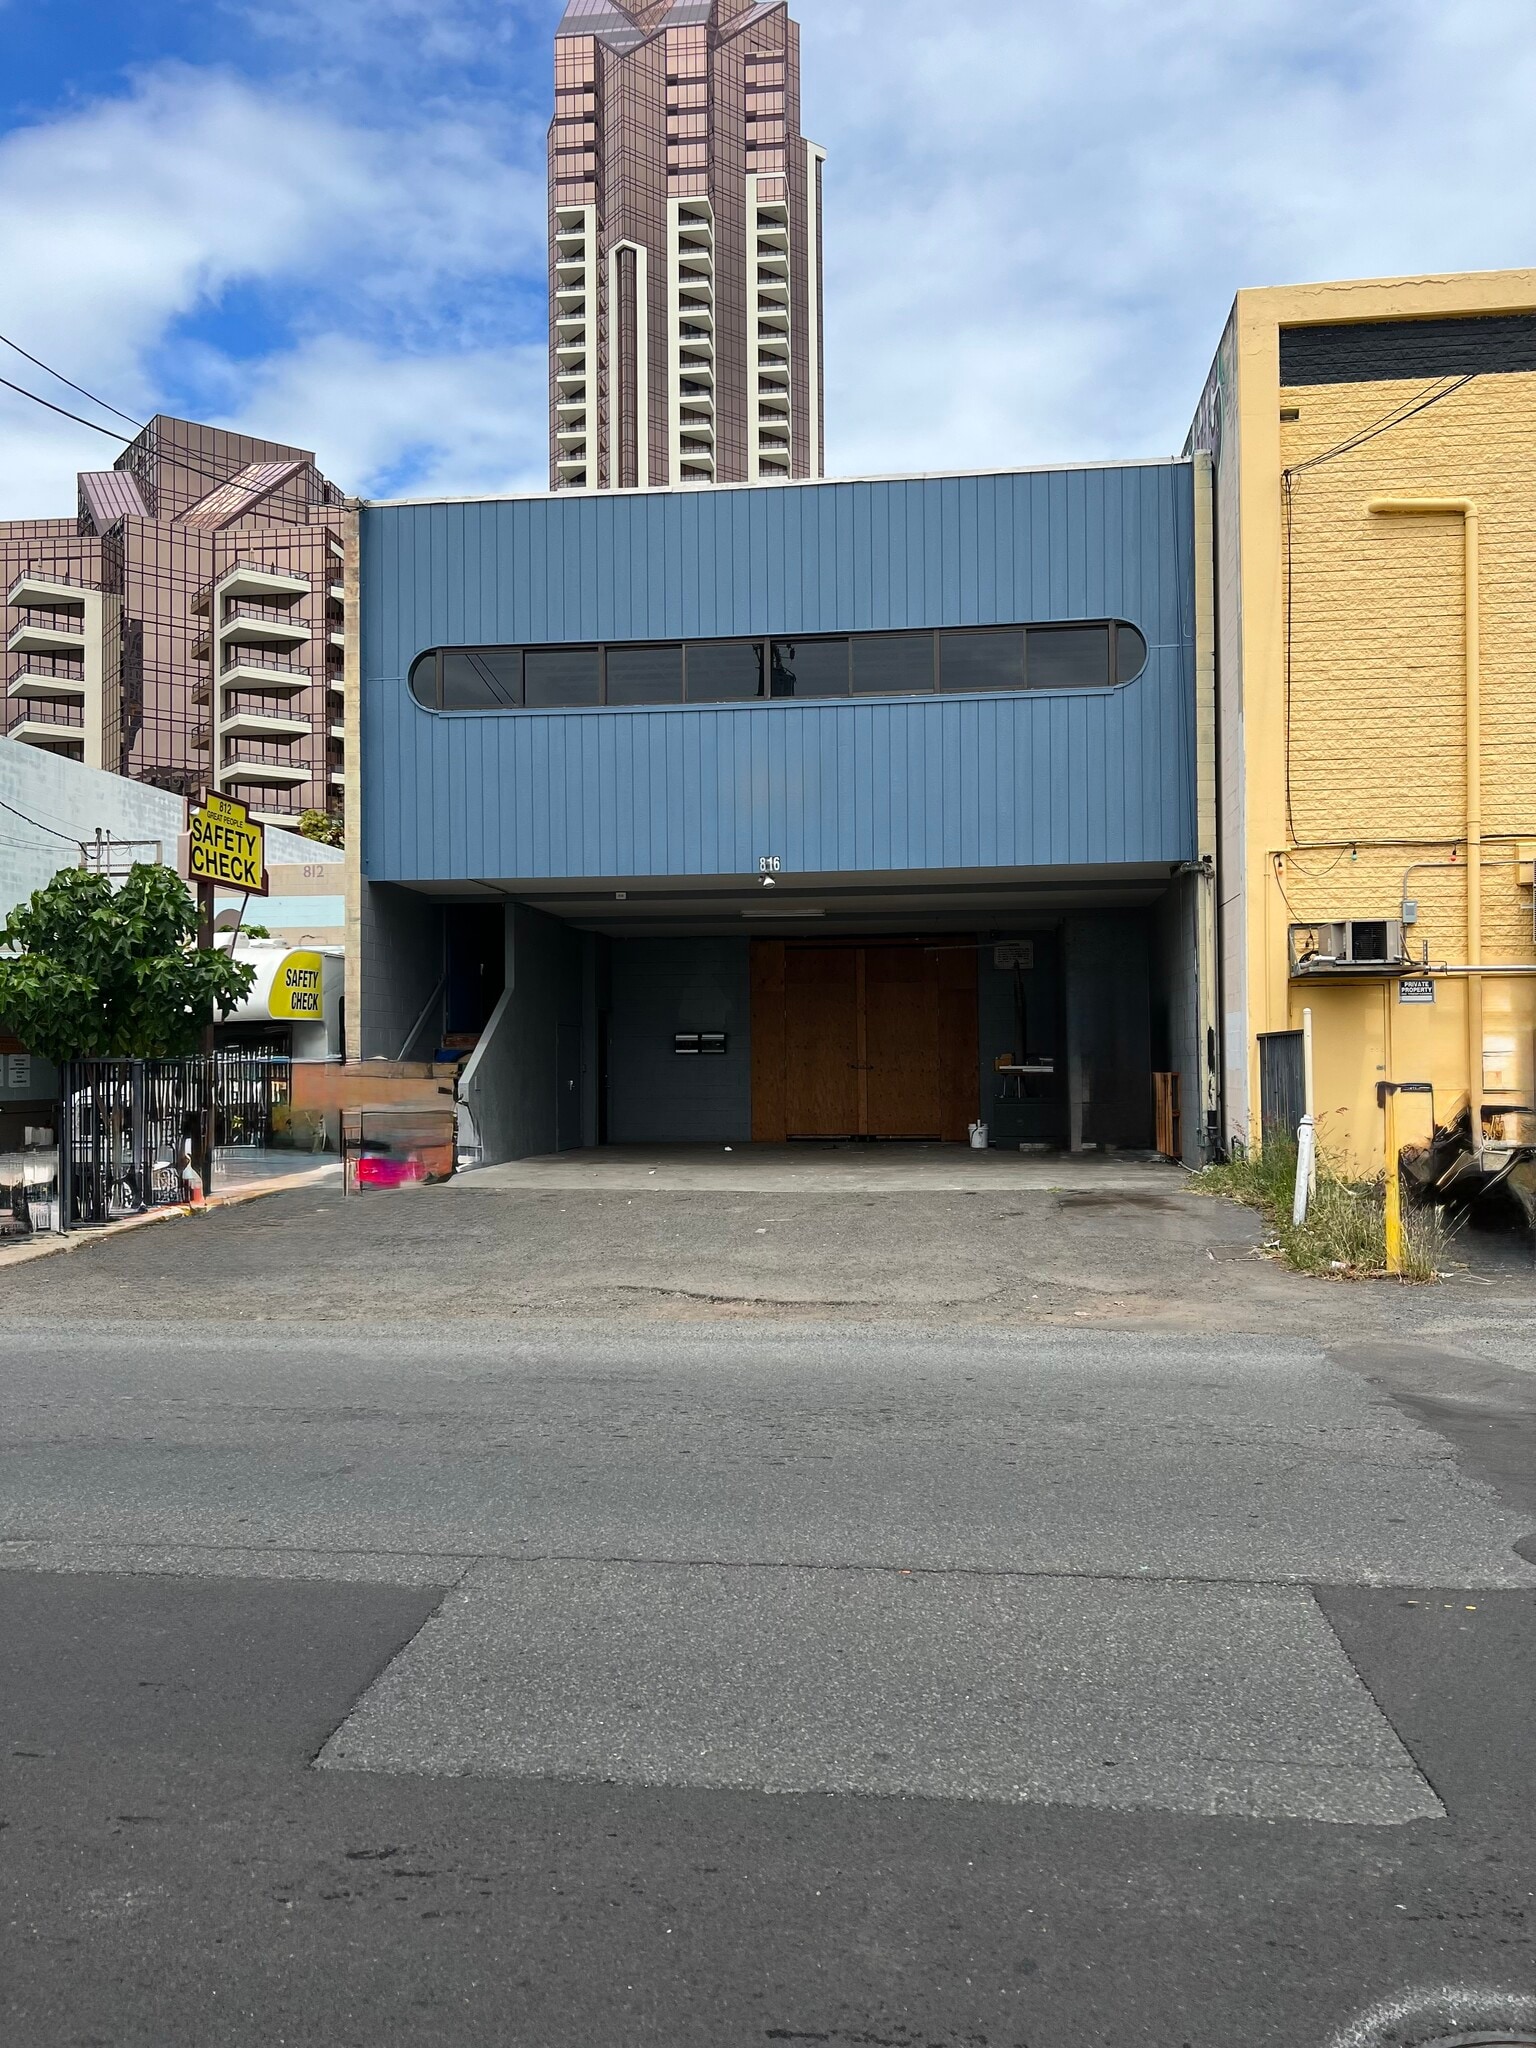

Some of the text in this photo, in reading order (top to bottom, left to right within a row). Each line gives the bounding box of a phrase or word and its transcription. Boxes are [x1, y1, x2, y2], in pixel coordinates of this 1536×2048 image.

[219, 801, 232, 815] 812
[207, 810, 243, 829] GREAT PEOPLE
[192, 818, 257, 857] SAFETY
[192, 846, 257, 885] CHECK
[303, 865, 325, 878] 812
[759, 856, 781, 871] 816
[286, 968, 319, 989] SAFETY
[291, 991, 319, 1011] CHECK
